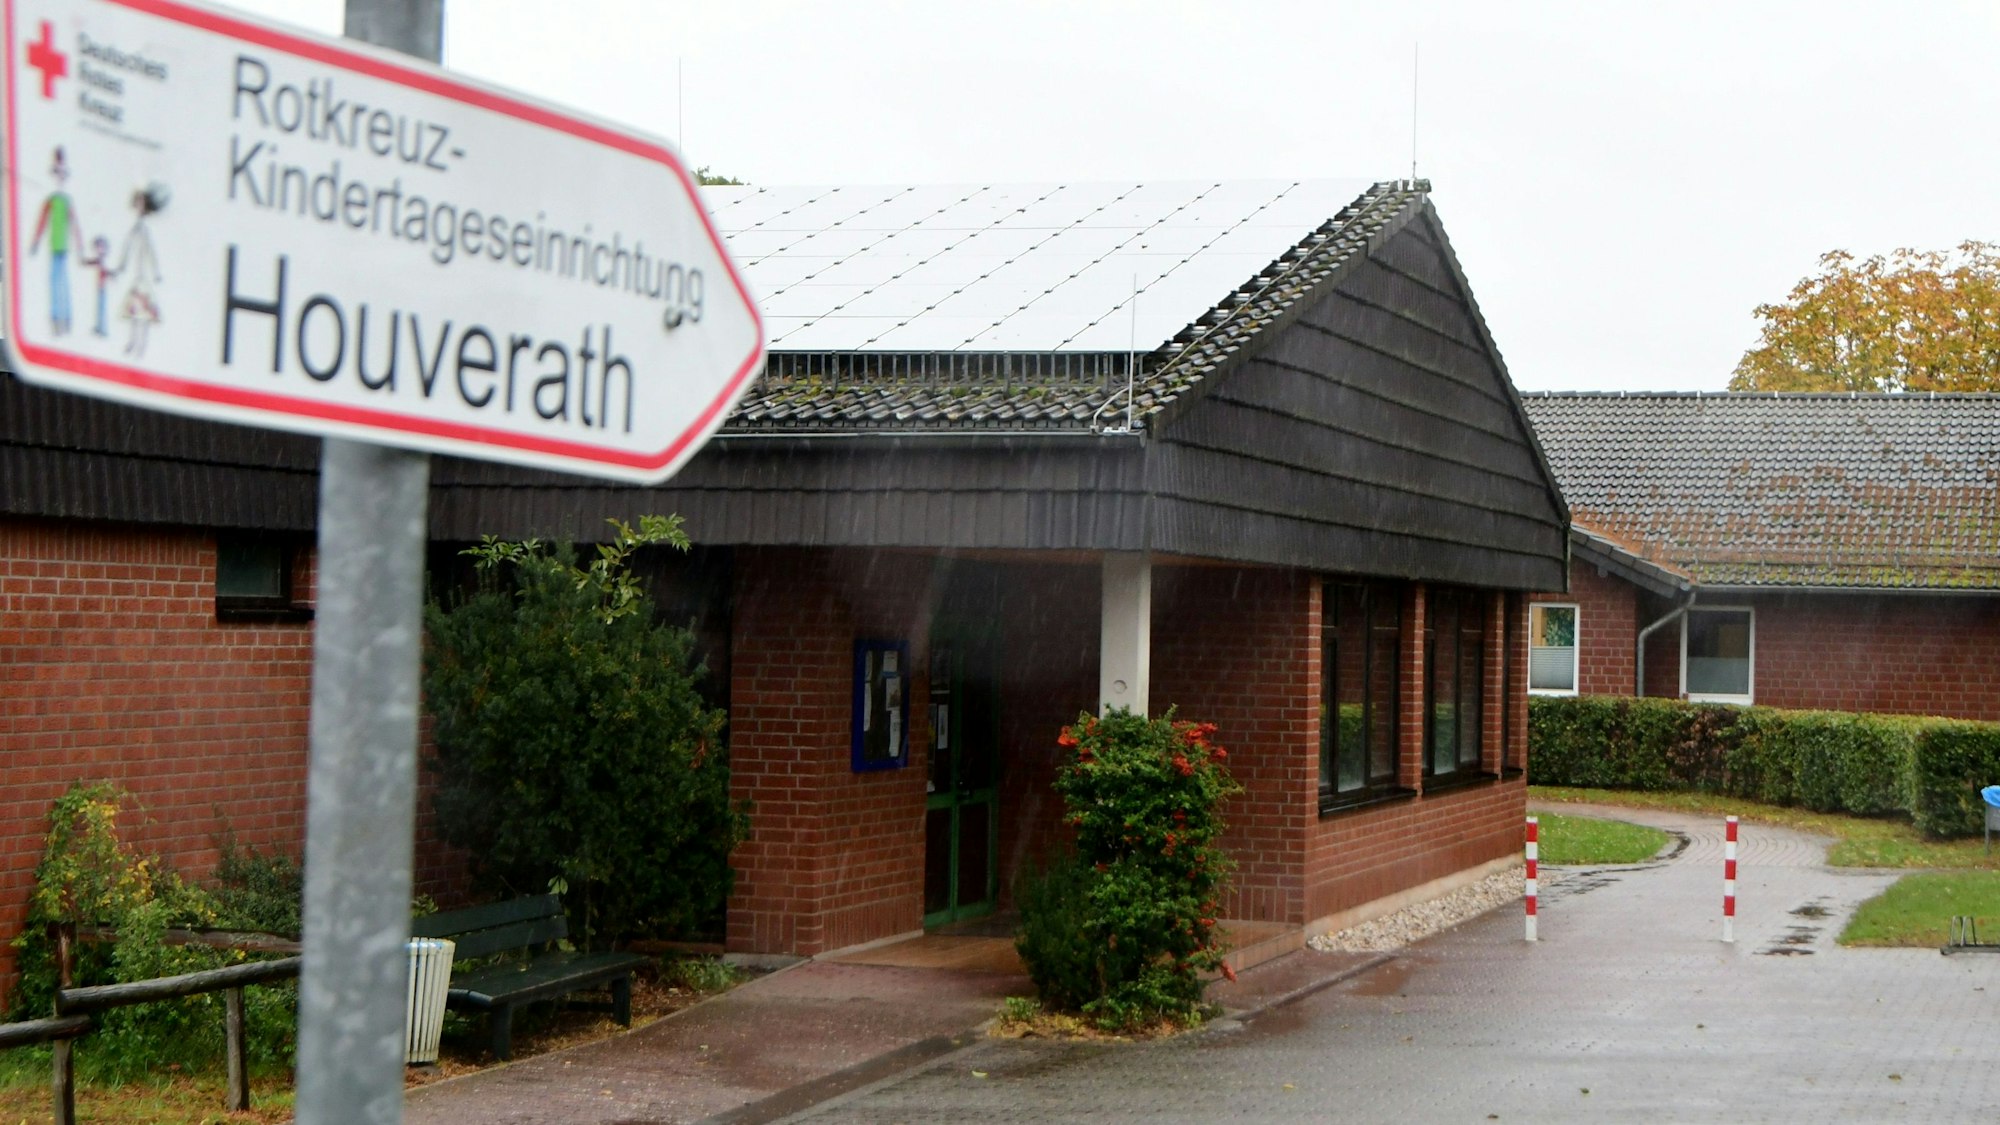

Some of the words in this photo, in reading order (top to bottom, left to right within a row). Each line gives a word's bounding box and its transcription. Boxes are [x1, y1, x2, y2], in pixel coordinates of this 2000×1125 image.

[232, 55, 466, 171] Rotkreuz-
[228, 135, 704, 323] Kindertageseinrichtung
[221, 244, 633, 434] Houverath
